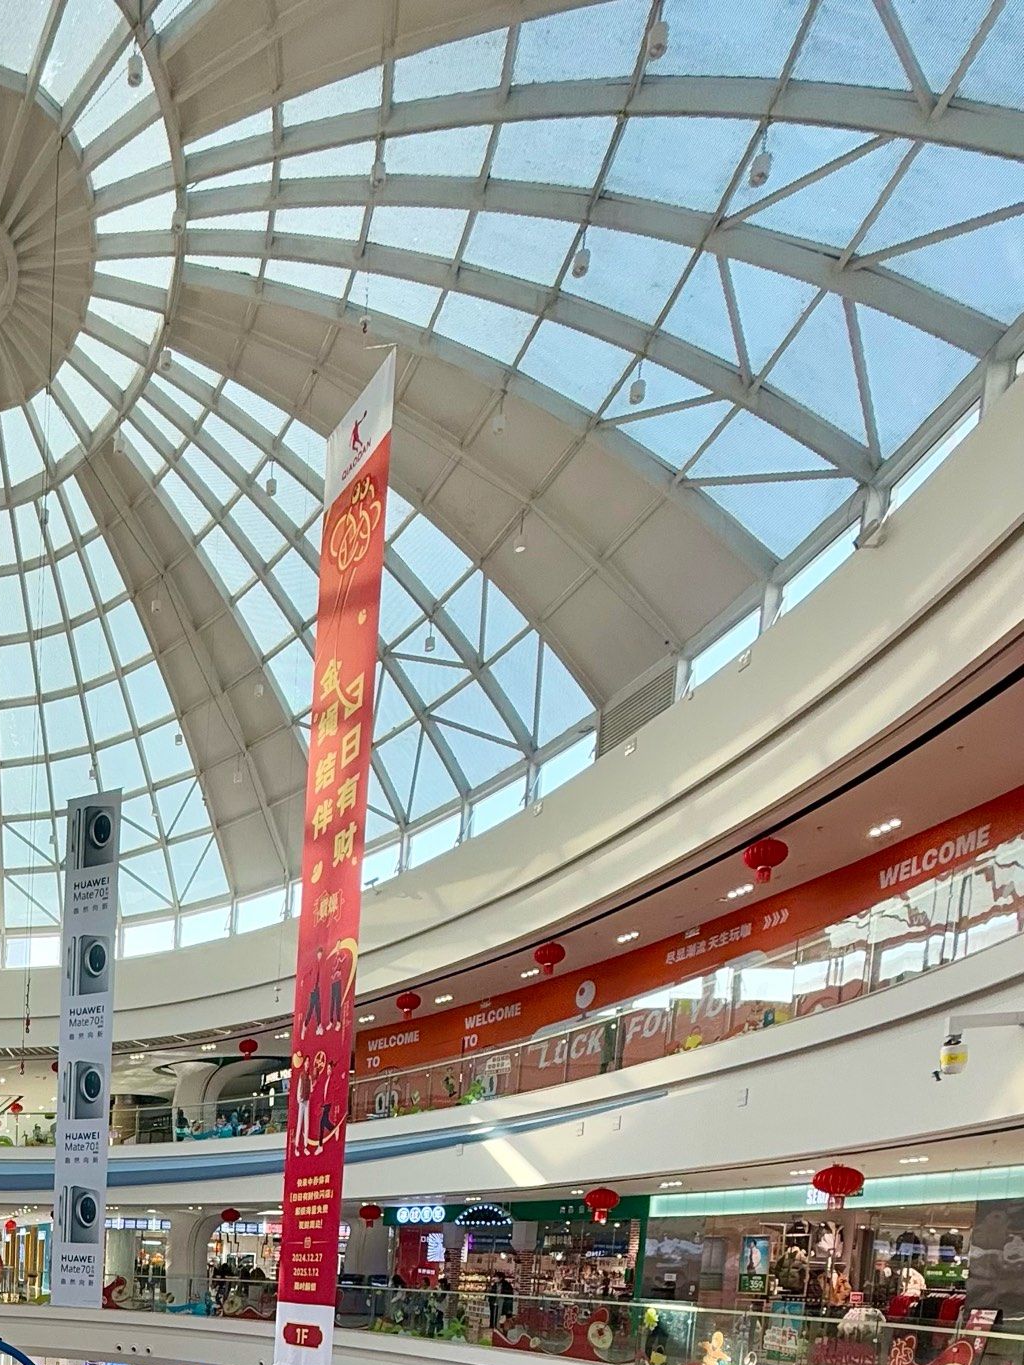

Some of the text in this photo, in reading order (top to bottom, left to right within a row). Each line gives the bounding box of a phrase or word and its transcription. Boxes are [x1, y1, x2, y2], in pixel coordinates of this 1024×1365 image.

[341, 439, 372, 481] QIAODAN
[879, 824, 991, 889] WELCOME
[73, 877, 110, 891] HUAWEI
[707, 923, 752, 950] 天生玩咖
[69, 1005, 105, 1016] HUAWEI
[464, 1002, 522, 1029] WELCOME
[367, 1031, 420, 1051] WELCOME
[463, 1034, 478, 1049] TO
[366, 1056, 381, 1068] TO
[65, 1132, 100, 1141] HUAWEI
[61, 1254, 96, 1264] HUAWEI
[292, 1253, 323, 1263] 2024.12.27
[293, 1267, 319, 1277] 2025.1.12
[295, 1328, 309, 1344] 1F
